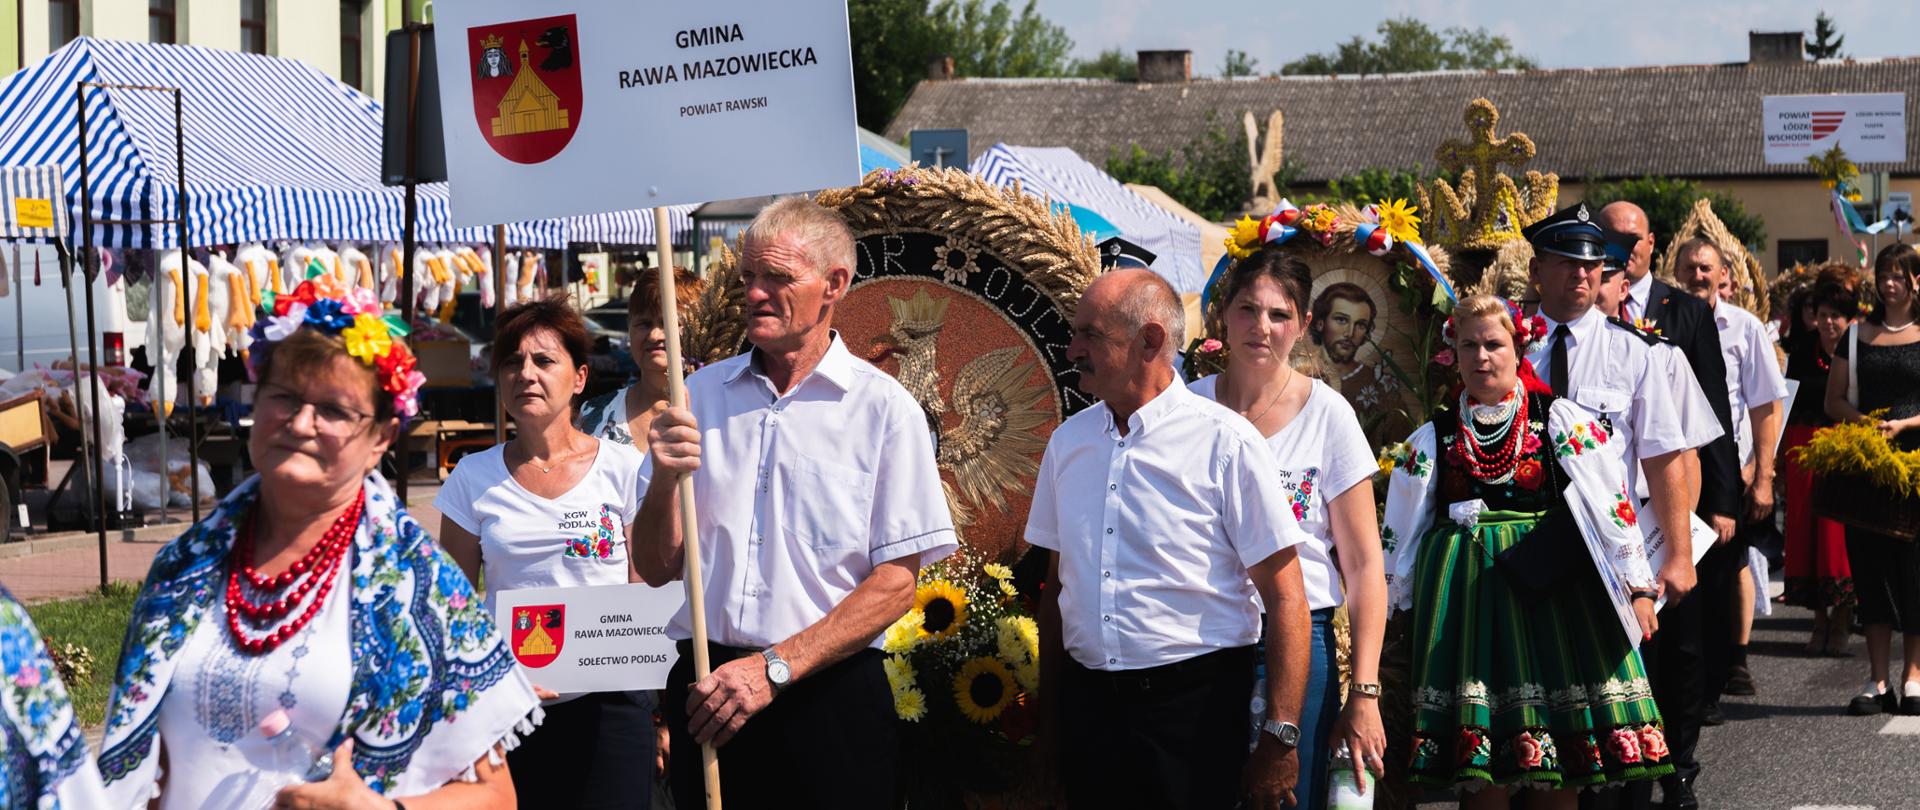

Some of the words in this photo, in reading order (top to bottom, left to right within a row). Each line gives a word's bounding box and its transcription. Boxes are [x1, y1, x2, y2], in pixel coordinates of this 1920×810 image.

[675, 23, 744, 49] GMINA
[619, 65, 678, 89] RAWA
[683, 46, 818, 81] MAZOWIECKA
[680, 102, 723, 117] POWIAT
[725, 96, 768, 112] RAWSKI
[1779, 111, 1810, 119] POWIAT
[1768, 133, 1812, 141] WSCHODNI
[564, 511, 588, 520] KGW
[558, 520, 597, 530] PODLAS
[600, 614, 633, 624] GMINA
[574, 629, 603, 639] RAWA
[578, 655, 629, 667] SOŁECTWO
[631, 654, 668, 665] PODLAS
